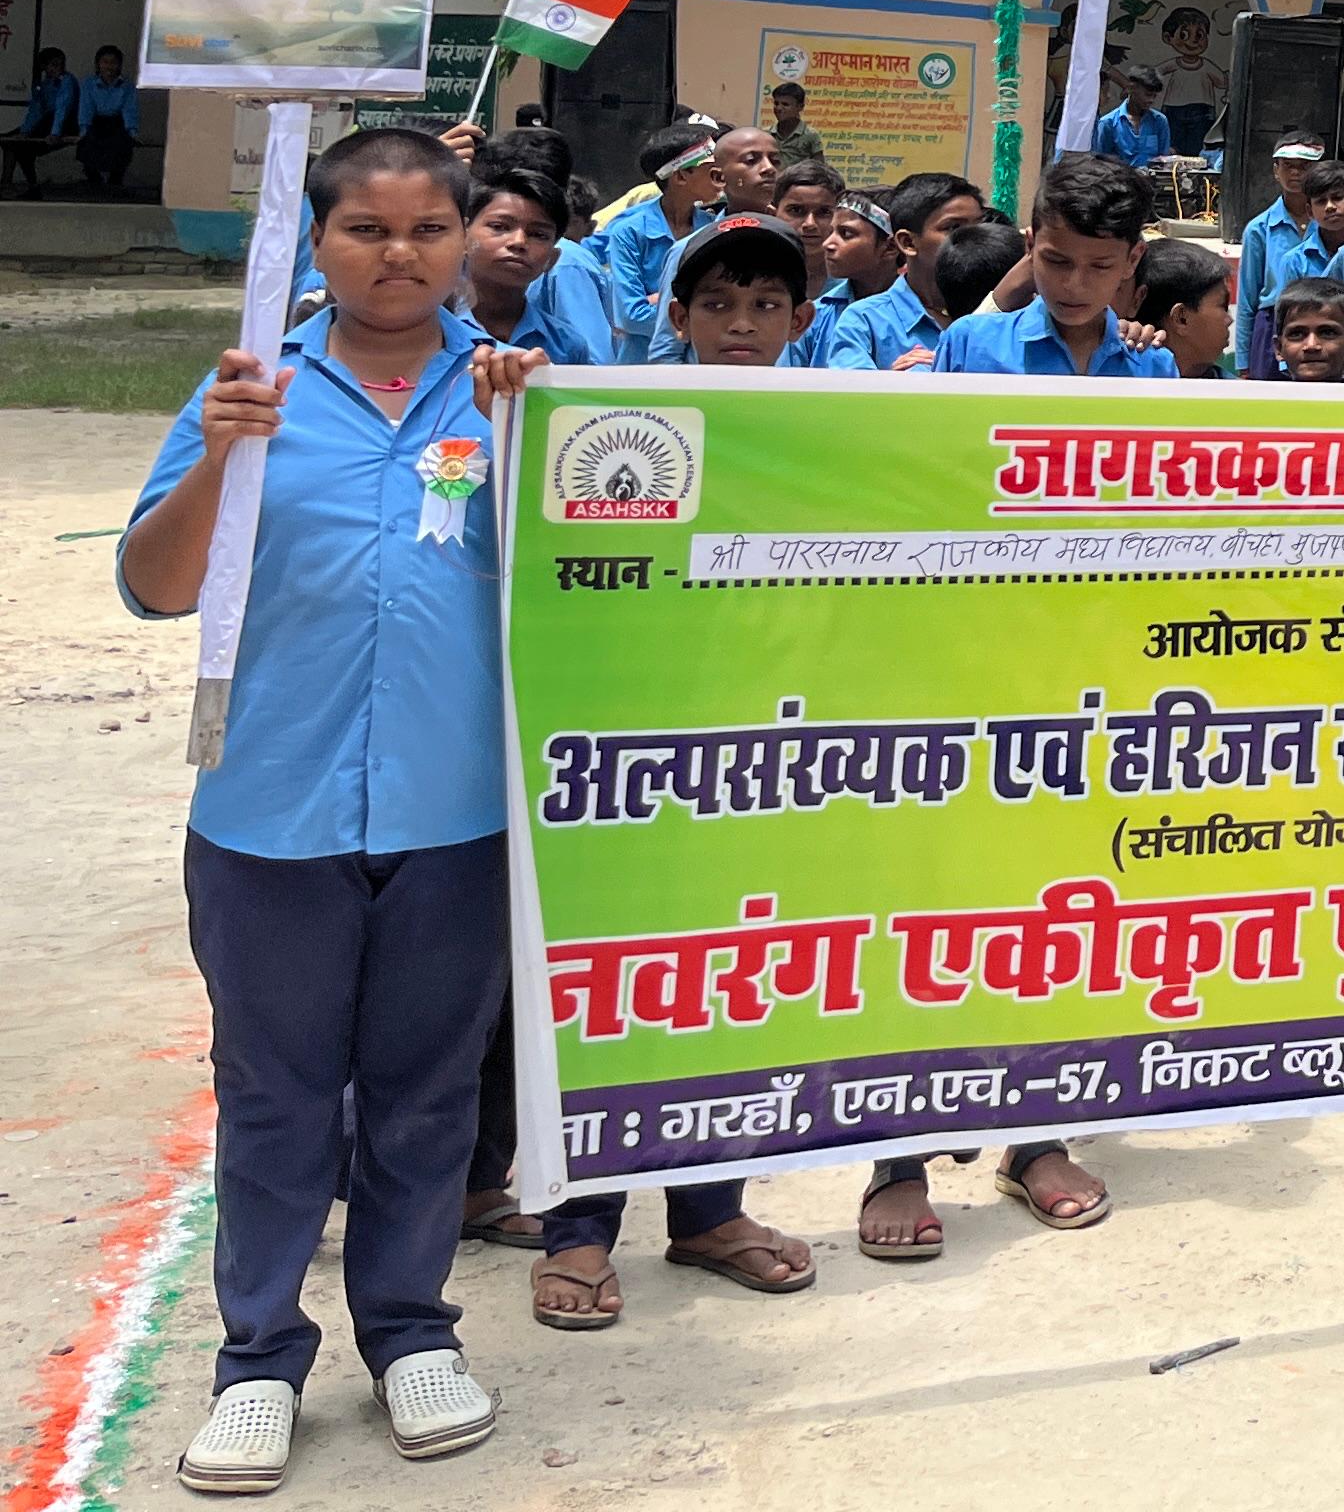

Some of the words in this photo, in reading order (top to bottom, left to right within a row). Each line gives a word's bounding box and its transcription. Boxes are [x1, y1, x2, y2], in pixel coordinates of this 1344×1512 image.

[811, 51, 874, 74] आयुष्मान
[874, 54, 910, 74] भारत
[574, 418, 599, 438] AVAM
[600, 410, 642, 422] HARIJAN
[643, 412, 674, 431] SAMAJ
[672, 430, 694, 462] KALYAN
[572, 503, 670, 518] ASAHSKK
[555, 556, 653, 591] स्थान
[710, 534, 750, 571] श्री
[769, 539, 903, 571] पारसनाथ
[1055, 536, 1114, 565] मध्य
[1143, 604, 1311, 660] आयोजक
[543, 699, 976, 825] अल्पसंख्यक
[987, 690, 1101, 801] एवं
[1107, 691, 1323, 792] हरिजन
[1111, 816, 1284, 872] (संचालित
[547, 896, 873, 1038] नवरंग
[893, 878, 1311, 1018] एकीकृत
[661, 1072, 812, 1142] गरहाँ,
[831, 1060, 1122, 1126] एन.एच.-57,
[1139, 1041, 1274, 1090] निकट
